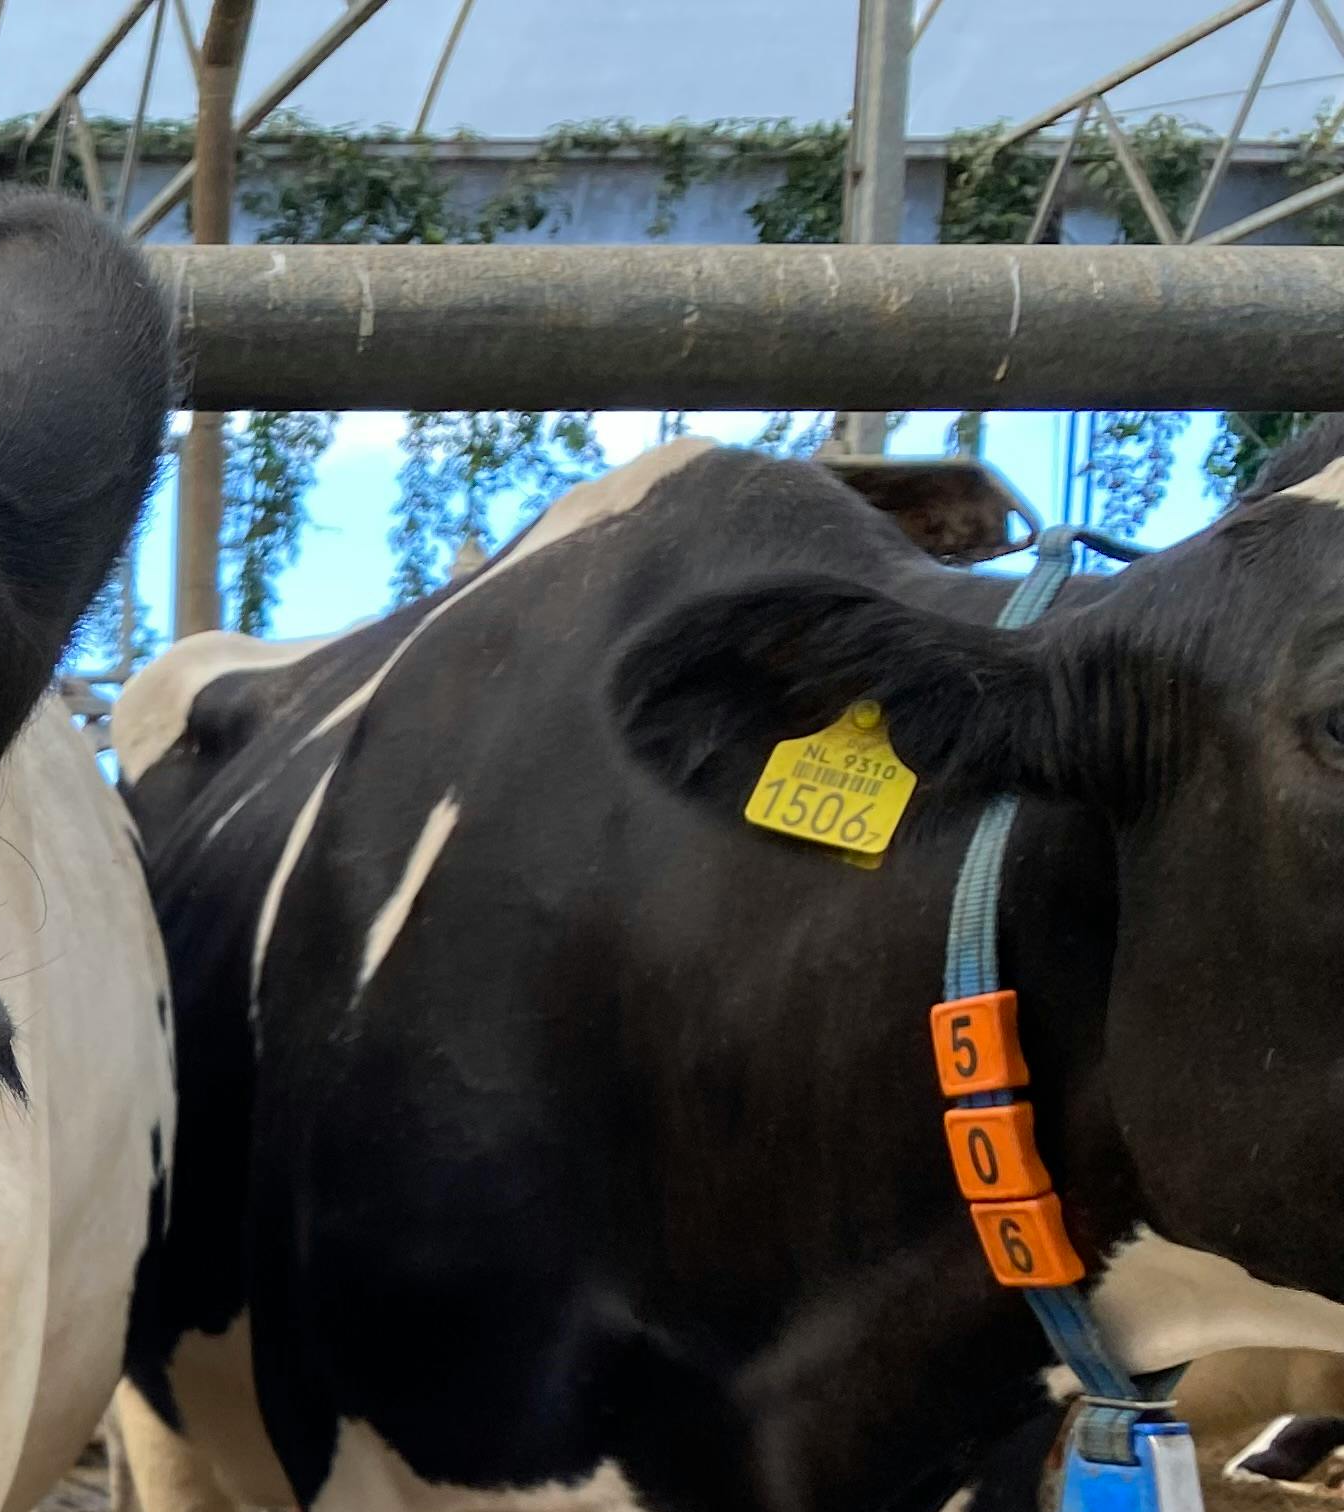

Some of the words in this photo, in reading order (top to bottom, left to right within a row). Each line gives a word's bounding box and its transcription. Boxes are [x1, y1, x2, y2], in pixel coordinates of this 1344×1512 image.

[803, 744, 831, 765] NL
[844, 755, 897, 780] 9310
[763, 778, 875, 843] 1506
[950, 1015, 978, 1077] 5
[999, 1218, 1033, 1274] 6
